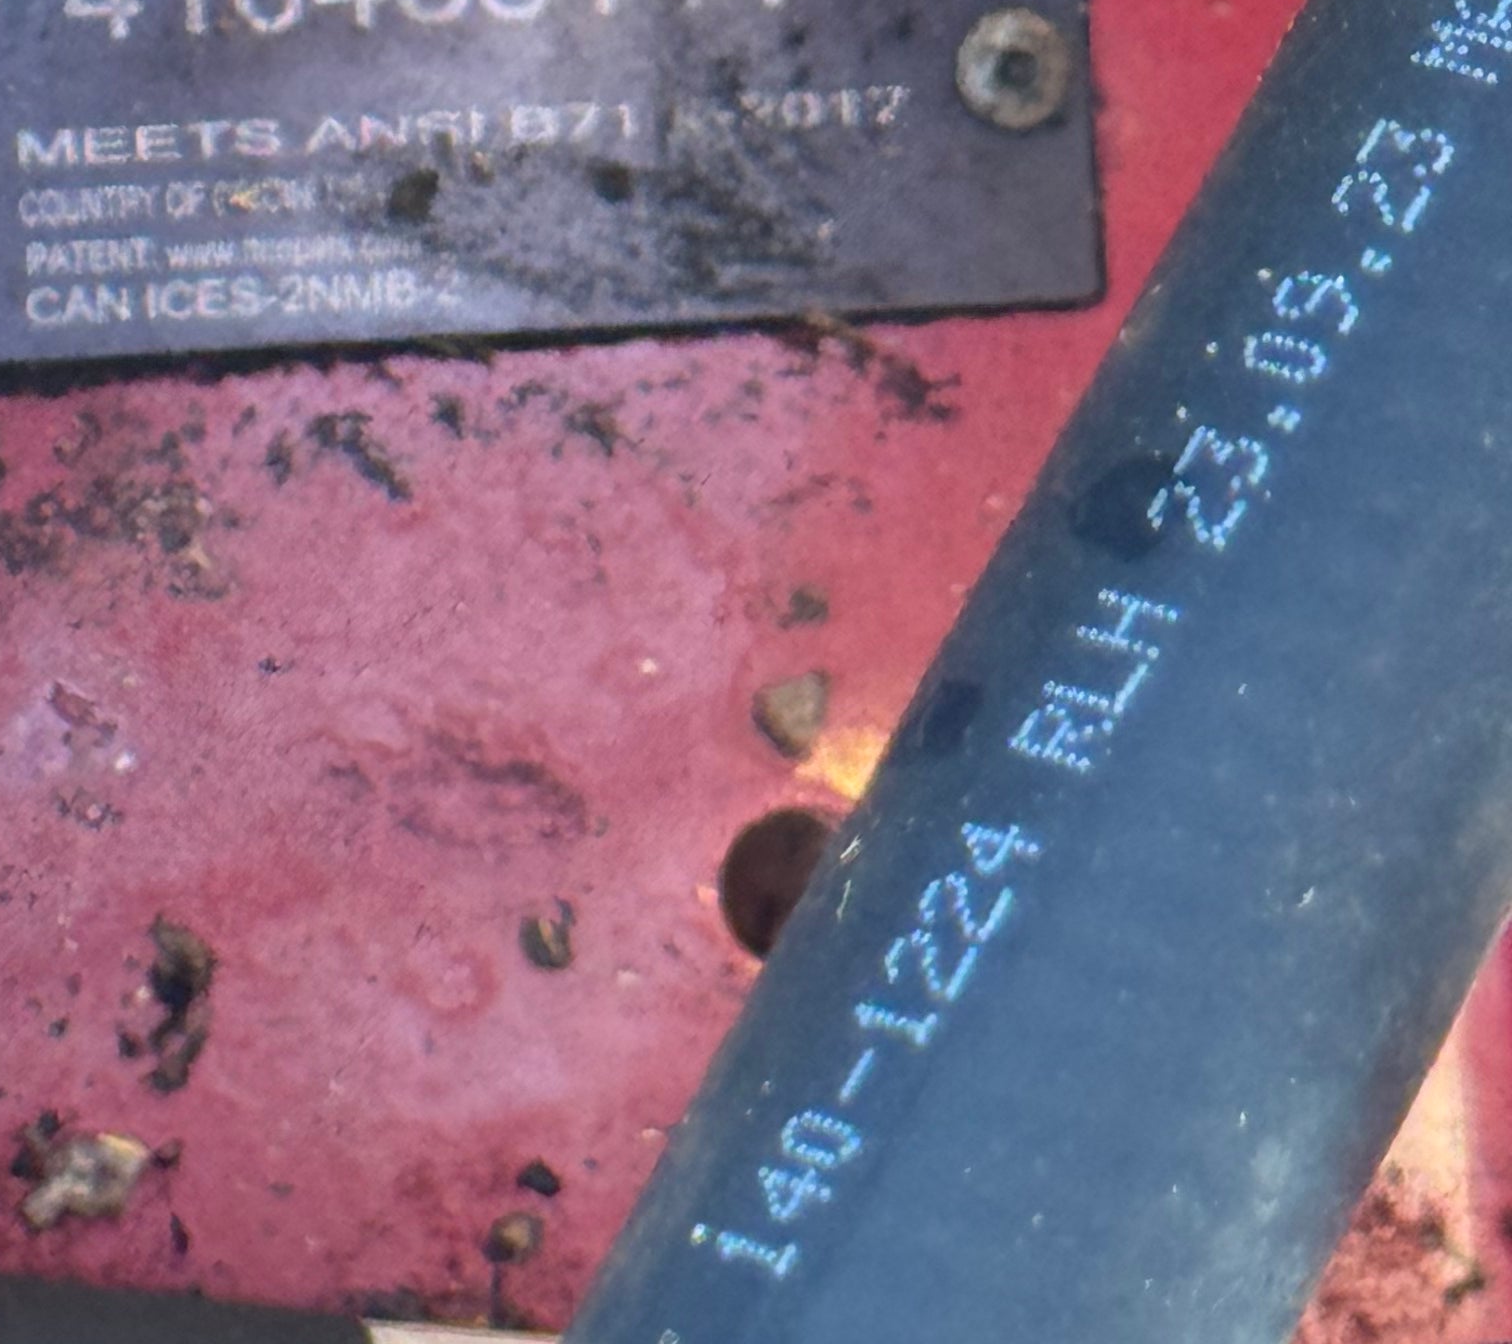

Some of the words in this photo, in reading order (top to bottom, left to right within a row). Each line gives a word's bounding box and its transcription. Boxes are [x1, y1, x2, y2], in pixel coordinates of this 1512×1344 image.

[16, 117, 283, 170] MEETS
[306, 108, 486, 156] ANSI
[18, 183, 156, 229] COUNTRY
[164, 179, 206, 219] OF
[25, 283, 131, 327] CAN
[710, 819, 1042, 1280] 140-1224
[1007, 585, 1181, 772] RLH
